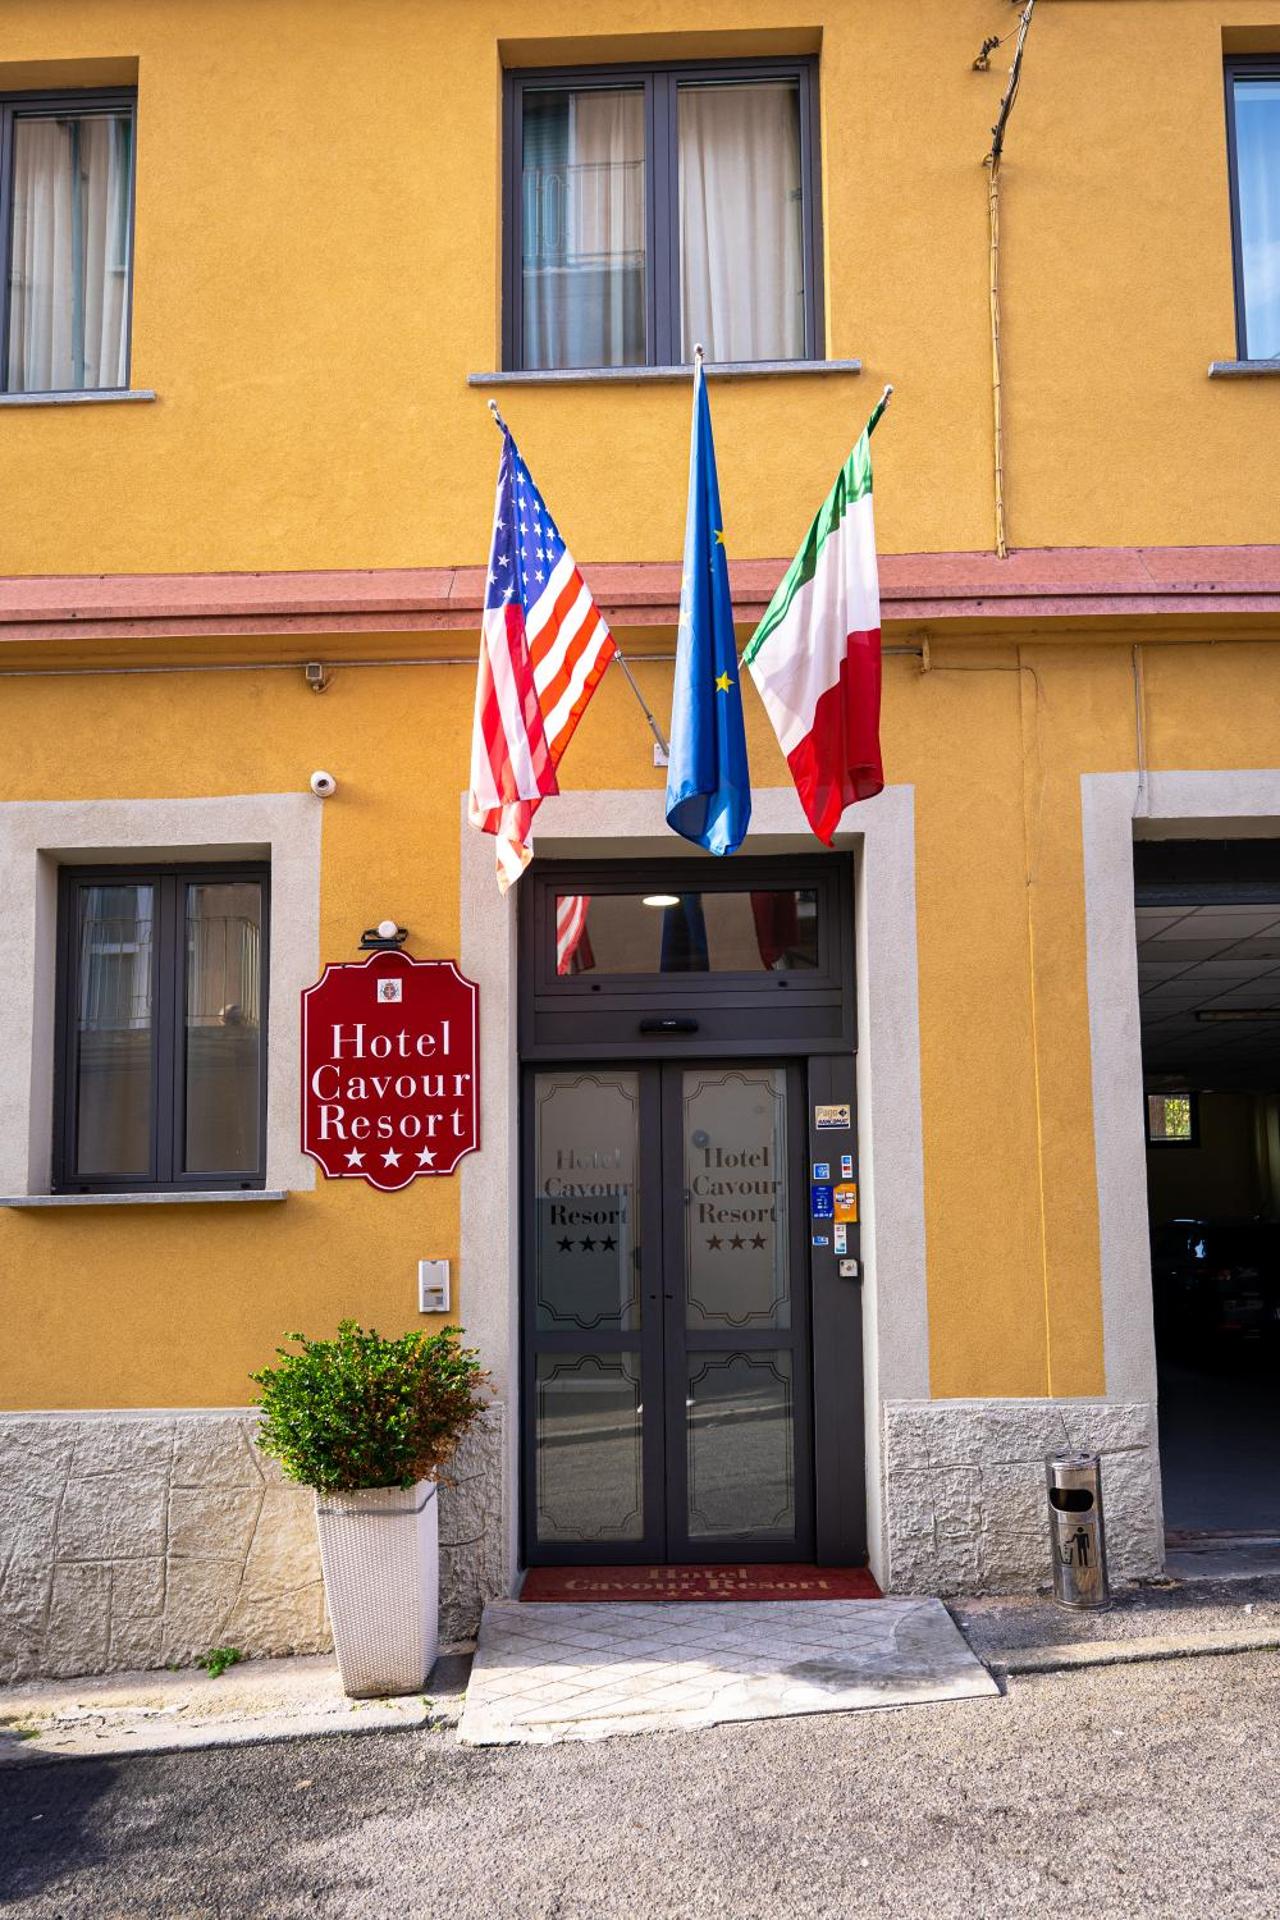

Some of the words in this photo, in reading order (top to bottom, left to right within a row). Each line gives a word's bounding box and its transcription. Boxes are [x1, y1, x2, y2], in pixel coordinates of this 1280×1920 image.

[330, 1020, 450, 1060] Hotel
[311, 1064, 471, 1101] Cavour
[316, 1104, 466, 1140] Resort
[703, 1146, 770, 1169] Hotel
[544, 1176, 634, 1198] Cavour
[692, 1174, 782, 1197] Cavour
[550, 1204, 628, 1226] Resort
[699, 1202, 779, 1224] Resort
[564, 1578, 697, 1591] Cavour
[708, 1578, 832, 1591] Resort
[647, 1568, 749, 1579] Hotel
